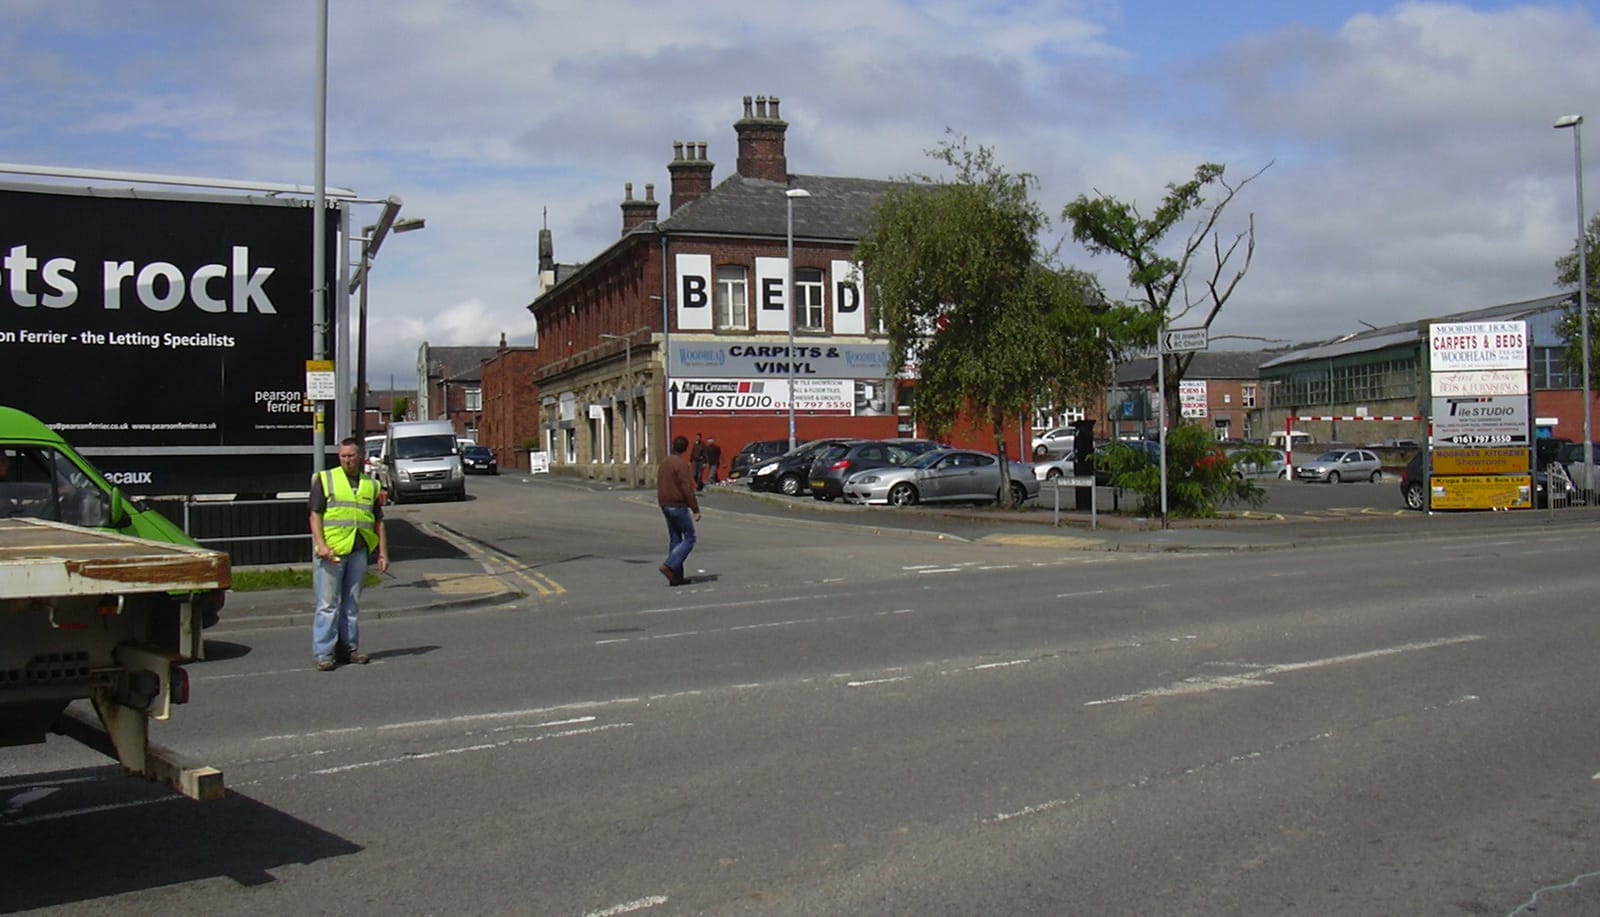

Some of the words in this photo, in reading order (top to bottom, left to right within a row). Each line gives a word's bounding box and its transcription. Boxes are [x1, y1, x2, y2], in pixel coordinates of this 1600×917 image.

[0, 244, 79, 309] ts
[103, 245, 278, 315] rock
[20, 330, 68, 344] Ferrier
[81, 331, 105, 345] the
[109, 332, 160, 349] Letting
[163, 333, 235, 349] Specialists
[1433, 335, 1478, 351] CARPETS
[1495, 334, 1523, 348] BEDS
[729, 345, 822, 358] CARPETS
[826, 347, 840, 358] &
[1441, 351, 1497, 362] WOODHEADS
[753, 362, 816, 374] VINYL
[255, 391, 301, 403] pearson
[715, 395, 772, 408] STUDIO
[267, 400, 302, 413] ferrier
[804, 401, 824, 409] 797
[1472, 406, 1514, 416] STUDIO
[1453, 435, 1473, 444] 0161
